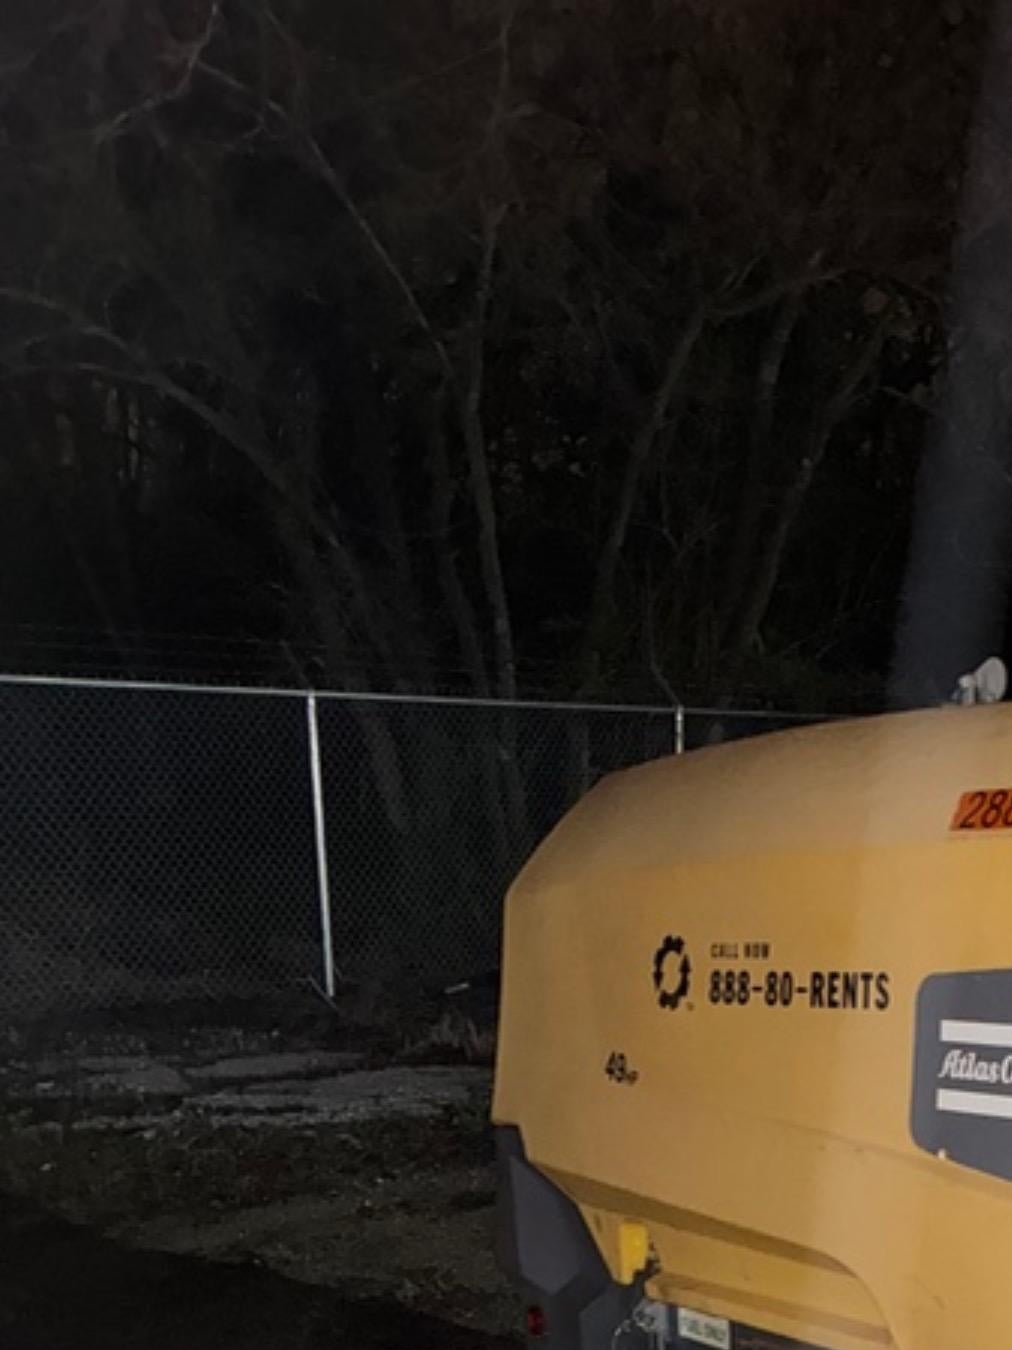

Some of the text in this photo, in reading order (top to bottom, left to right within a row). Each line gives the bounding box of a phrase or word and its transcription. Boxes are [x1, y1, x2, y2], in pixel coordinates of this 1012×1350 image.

[710, 943, 771, 959] CALL NOW
[709, 969, 890, 1010] 888-80-RENTS
[938, 1049, 1000, 1083] Atlas
